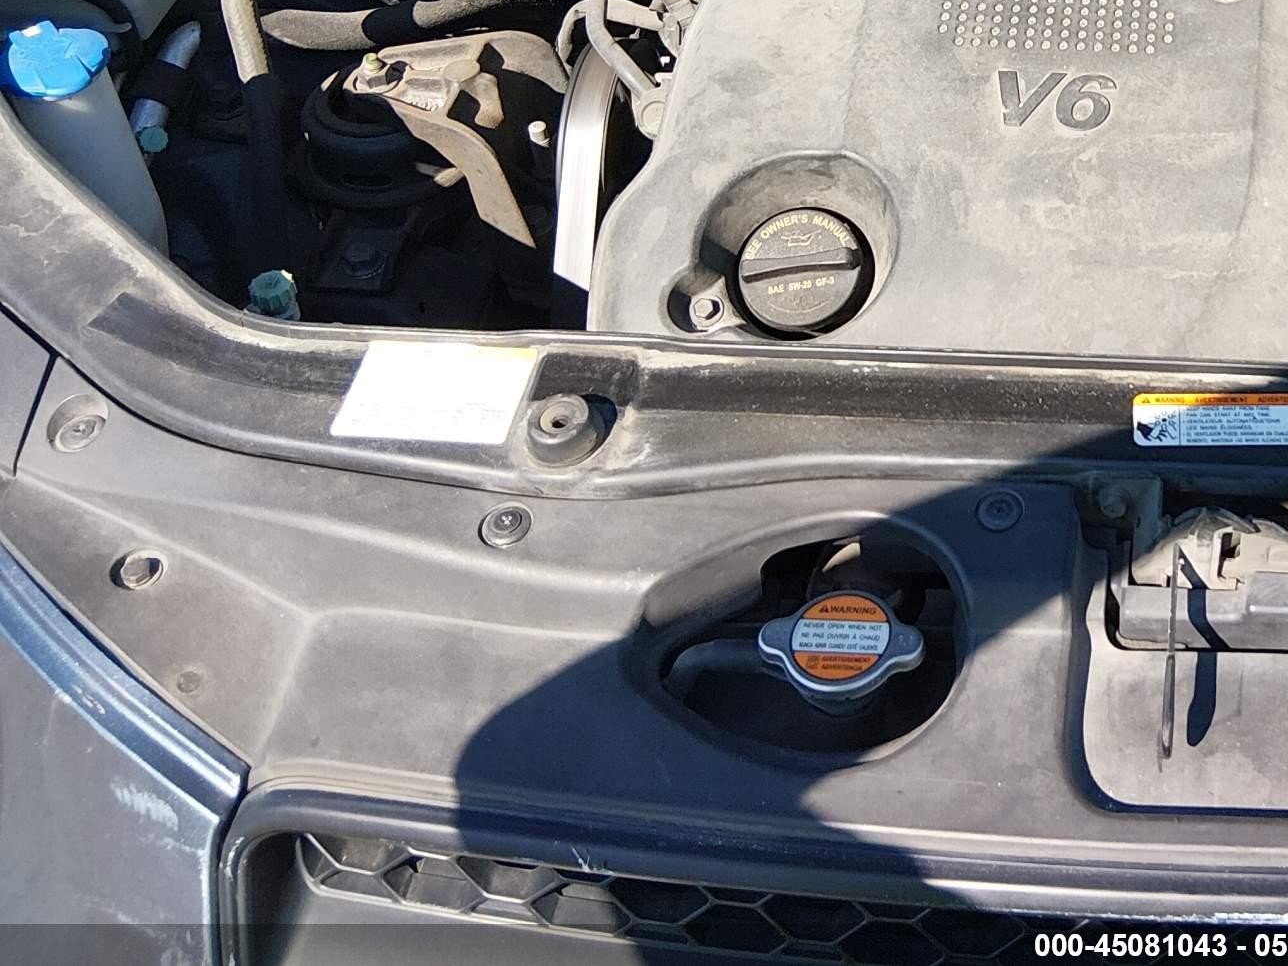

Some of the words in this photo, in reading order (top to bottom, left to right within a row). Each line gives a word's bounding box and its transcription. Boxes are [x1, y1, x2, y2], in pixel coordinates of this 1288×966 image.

[998, 70, 1118, 131] V6
[746, 240, 762, 260] SEE
[761, 214, 809, 240] OWNER'S
[812, 215, 849, 245] MANUAL
[768, 284, 785, 295] SAE
[830, 605, 877, 615] WARNING
[803, 622, 825, 630] NEVER
